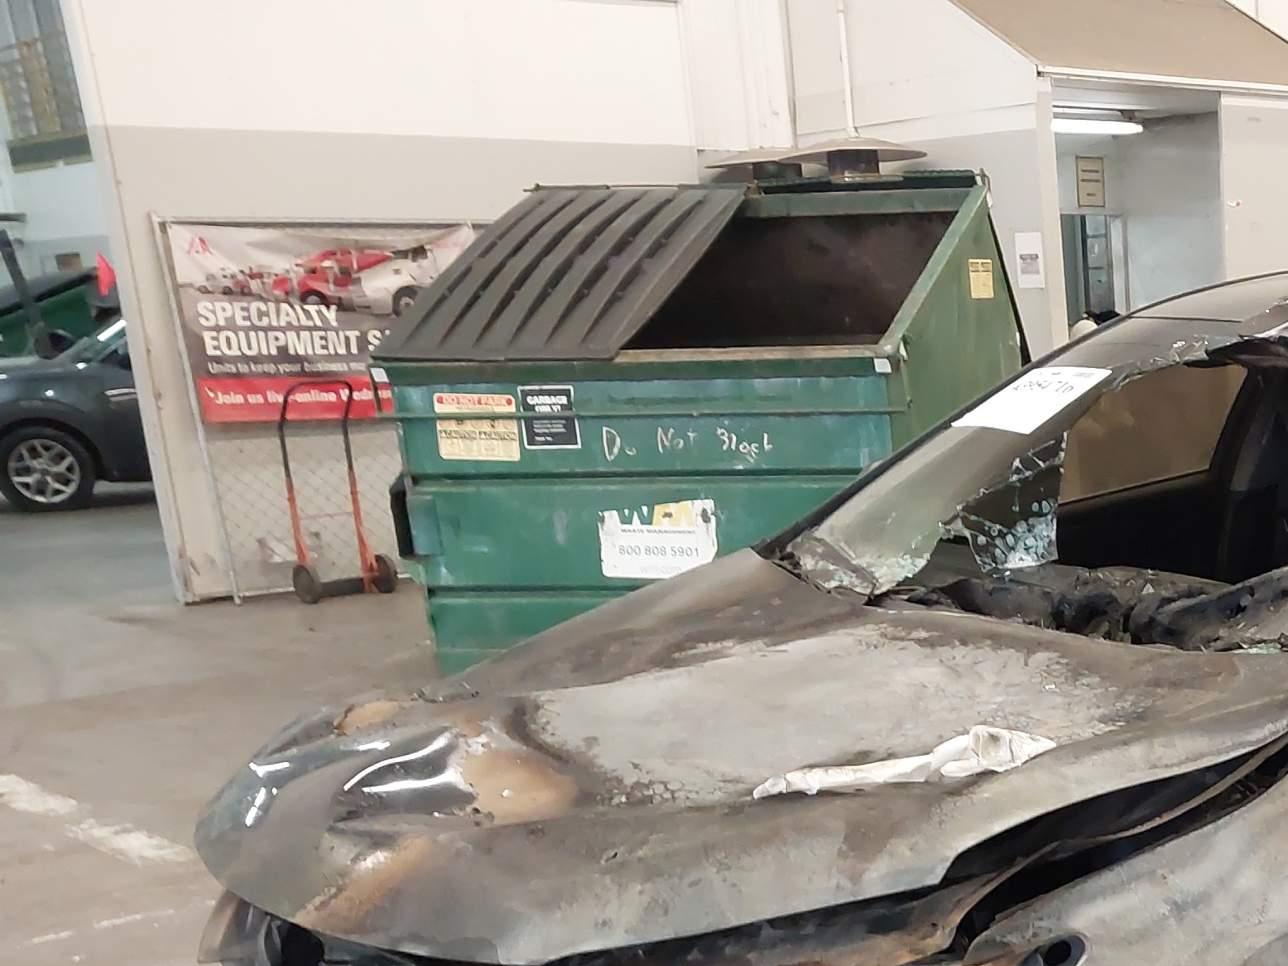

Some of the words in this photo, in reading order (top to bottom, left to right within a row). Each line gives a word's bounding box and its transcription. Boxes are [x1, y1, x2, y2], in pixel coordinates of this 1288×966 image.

[197, 301, 338, 327] SPECIALTY
[203, 330, 360, 356] EQUIPMENT
[216, 391, 244, 404] Join
[246, 393, 264, 404] us
[602, 426, 637, 462] Do
[657, 427, 698, 454] Not
[618, 544, 642, 556] 800
[644, 545, 667, 557] 808
[670, 545, 700, 558] 5901
